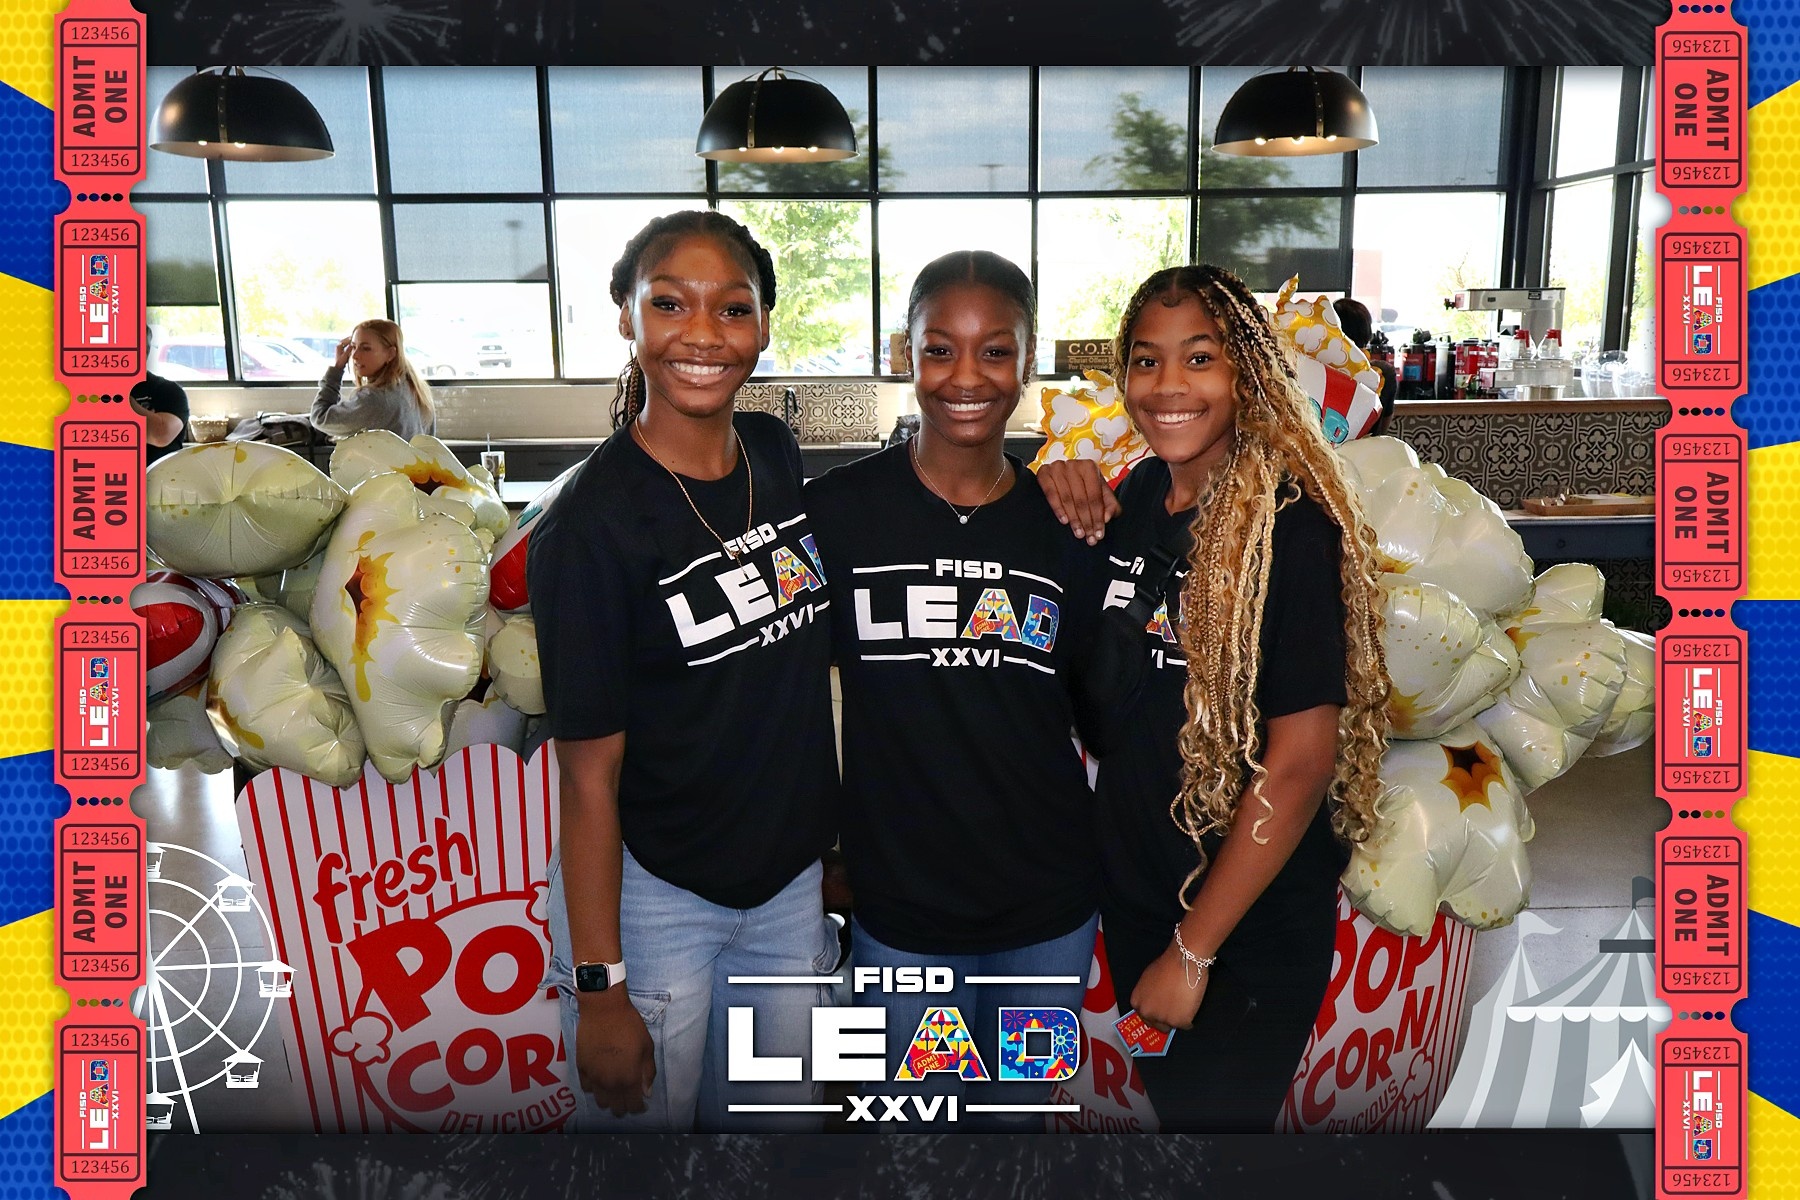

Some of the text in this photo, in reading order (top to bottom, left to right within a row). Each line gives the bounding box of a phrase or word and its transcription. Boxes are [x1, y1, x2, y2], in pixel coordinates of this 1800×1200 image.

[722, 522, 778, 561] FISD
[935, 558, 1003, 580] FISD
[759, 603, 814, 648] XXVI
[854, 585, 1060, 653] LEAD
[930, 647, 1000, 668] XXVI
[313, 817, 474, 944] fresh
[346, 918, 560, 1032] PO
[387, 1028, 567, 1112] COR
[1301, 985, 1435, 1126] CORN
[439, 1086, 577, 1134] DELICIOUS
[1325, 1079, 1399, 1134] DELICIOUS
